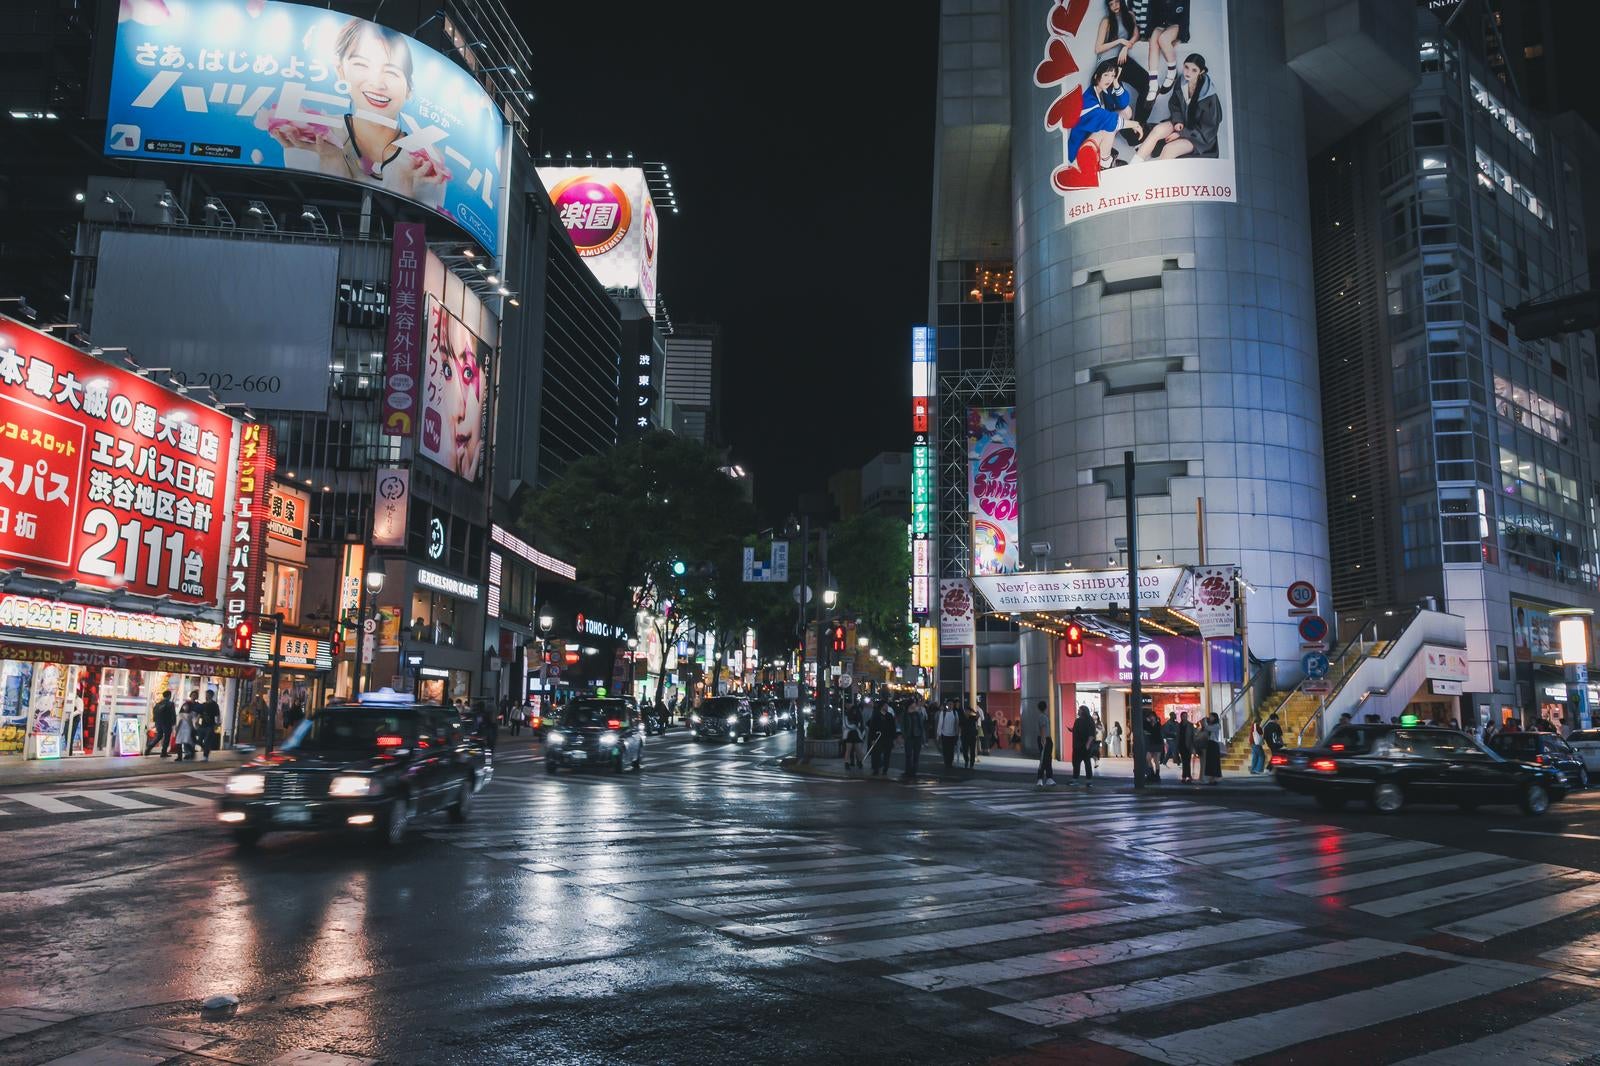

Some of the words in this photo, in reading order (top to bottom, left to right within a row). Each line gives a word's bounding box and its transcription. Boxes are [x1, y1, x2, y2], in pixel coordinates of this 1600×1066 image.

[560, 201, 619, 230] 楽園
[1069, 203, 1094, 218] 45th
[1098, 193, 1141, 210] Anniv.
[1145, 185, 1232, 200] SHIBUYA109
[580, 227, 626, 257] AMUSEMENT
[391, 250, 417, 372] 品川美容外科
[637, 354, 650, 427] 渋東シネ
[90, 431, 216, 499] エスパス日拓
[240, 423, 260, 492] パチンコ
[88, 468, 214, 533] 渋谷地区合計
[181, 582, 204, 596] OVER
[421, 568, 458, 595] EXCELSIOR
[996, 581, 1060, 594] NewJeans
[1000, 596, 1020, 605] 45th
[1023, 593, 1098, 604] ANNIVERSARY
[585, 618, 603, 636] TOHO
